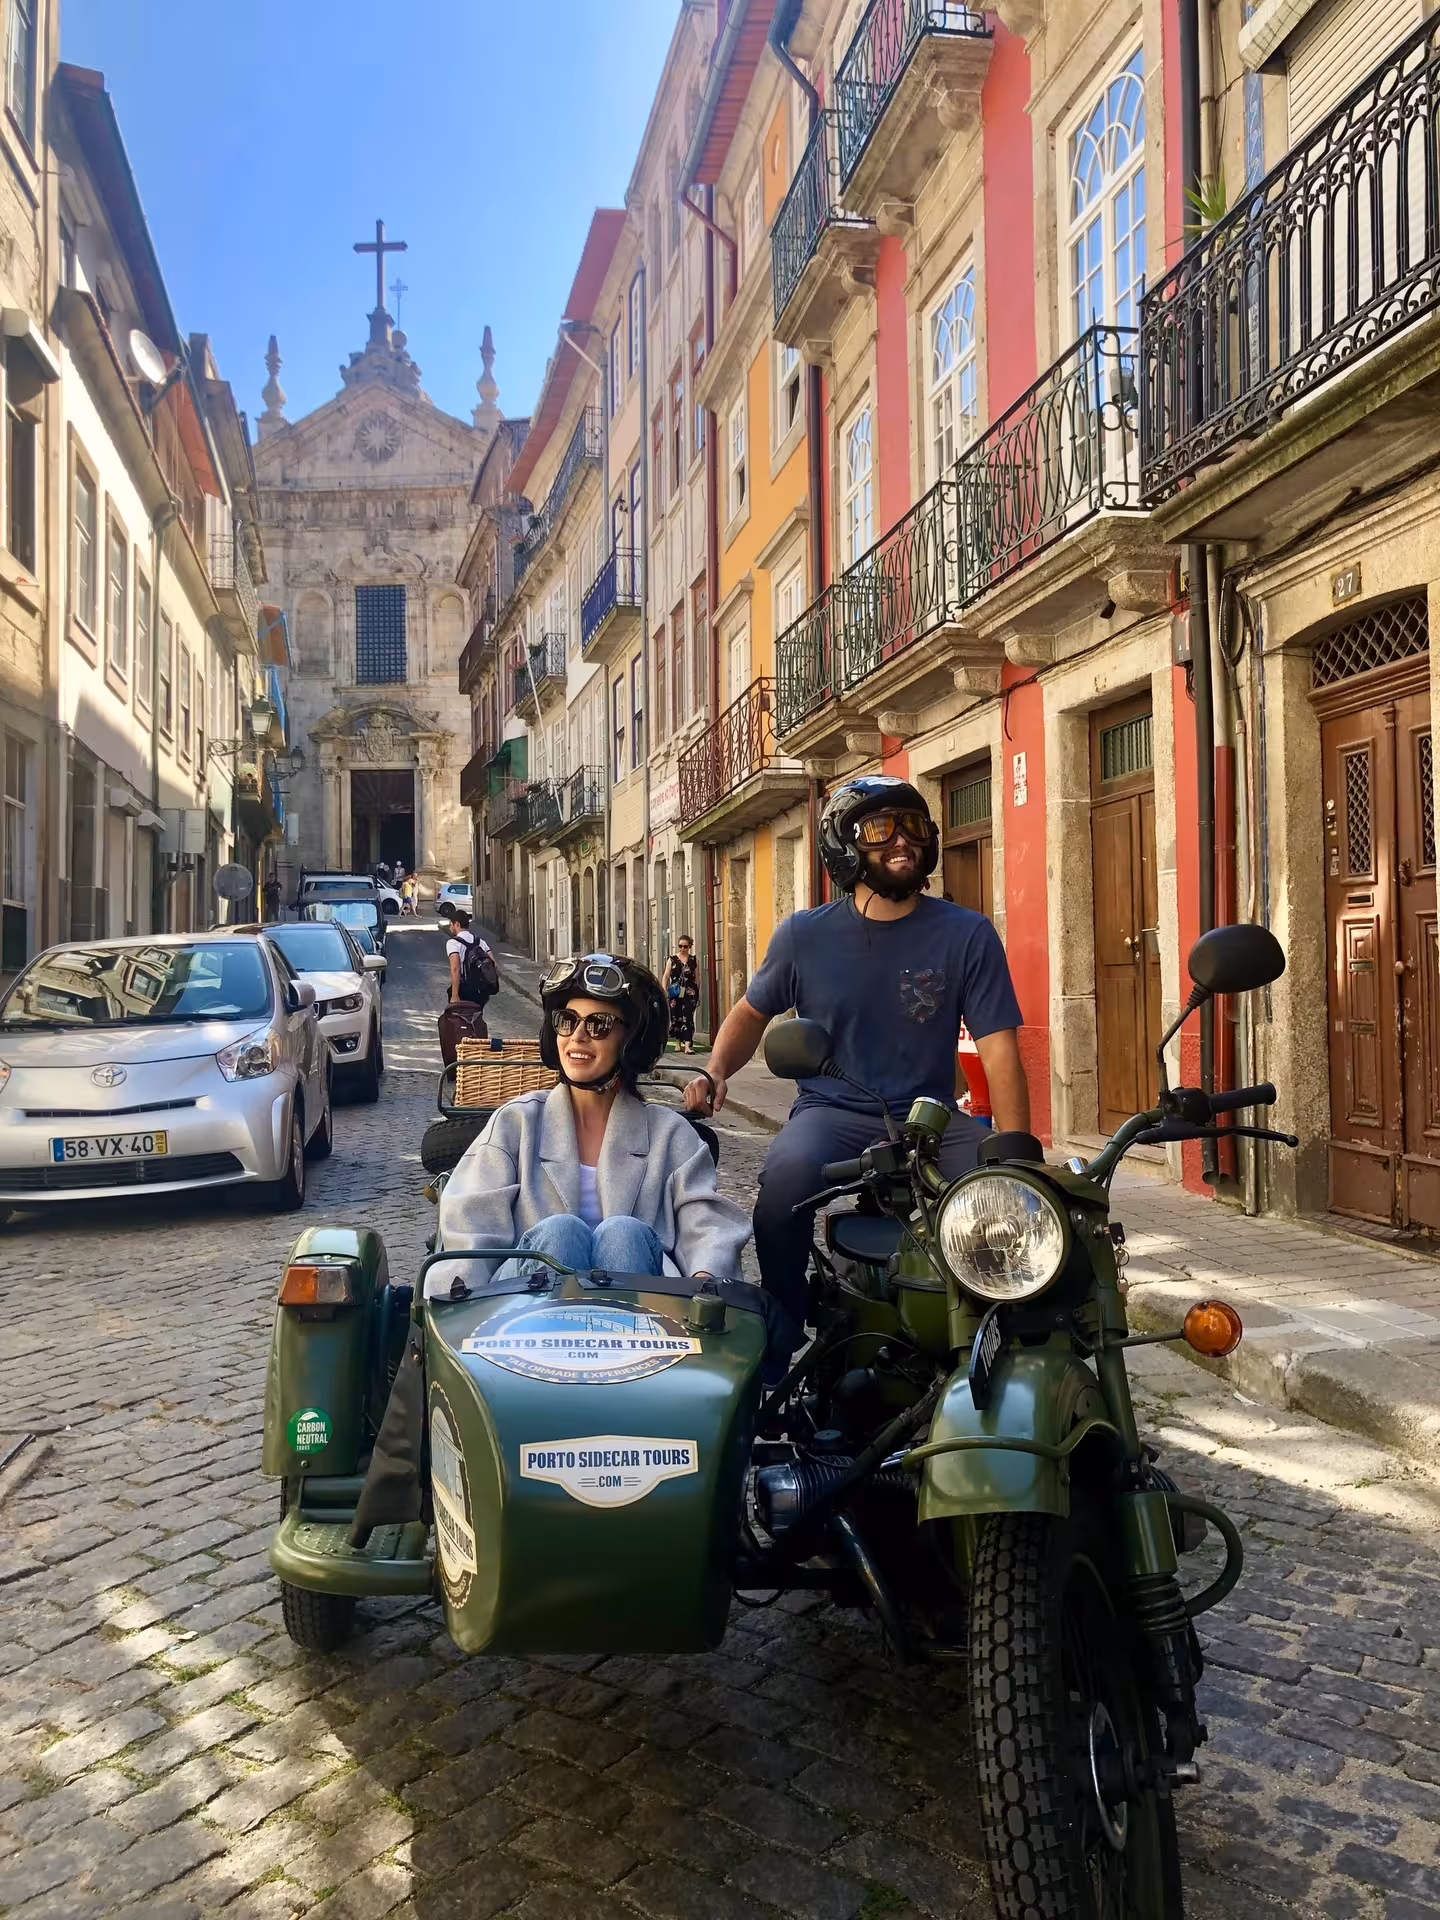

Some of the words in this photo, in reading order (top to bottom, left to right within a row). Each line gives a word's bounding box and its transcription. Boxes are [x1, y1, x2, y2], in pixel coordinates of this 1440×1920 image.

[1337, 572, 1353, 597] 27
[473, 1339, 536, 1349] PORTO
[541, 1339, 623, 1349] SIDECAR
[627, 1339, 690, 1350] TOURS
[564, 1351, 599, 1359] .COM
[506, 1356, 579, 1378] TAILORMADE
[583, 1358, 660, 1379] EXPERIENCES
[297, 1421, 326, 1433] CARBON
[296, 1433, 329, 1445] NEUTRAL
[527, 1451, 575, 1469] PORTO
[579, 1450, 641, 1468] SIDECAR
[643, 1449, 690, 1466] TOURS
[595, 1475, 622, 1488] .COM
[455, 1522, 474, 1561] TOURS
